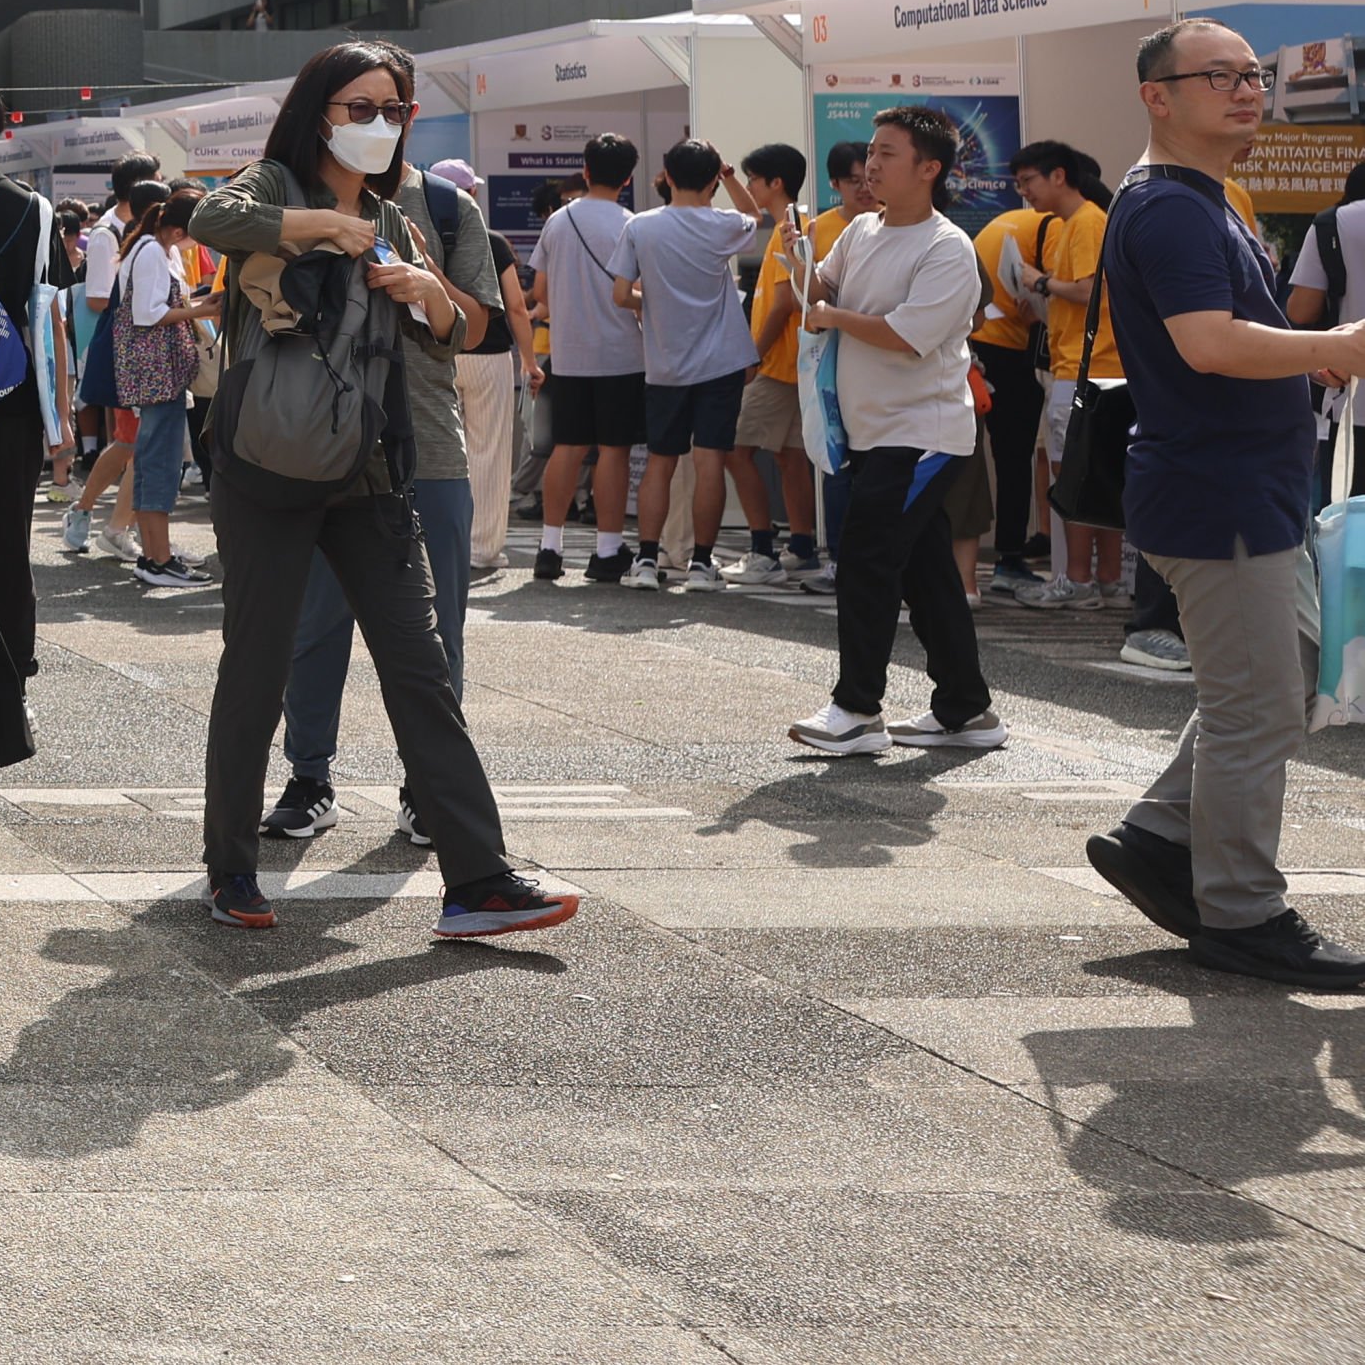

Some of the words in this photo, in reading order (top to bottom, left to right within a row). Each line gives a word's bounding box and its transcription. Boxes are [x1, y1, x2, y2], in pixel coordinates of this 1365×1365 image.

[812, 14, 828, 44] 03
[555, 62, 587, 82] Statistics
[826, 109, 861, 120] JS4416
[1274, 132, 1299, 144] Major
[1302, 132, 1353, 144] Programme
[194, 146, 219, 156] CUHK
[1248, 146, 1332, 158] UANTITATIVE
[521, 156, 544, 166] What
[546, 156, 552, 166] is
[555, 156, 586, 166] Statisti
[1268, 160, 1360, 173] MANAGEMEN
[962, 178, 1007, 191] Science
